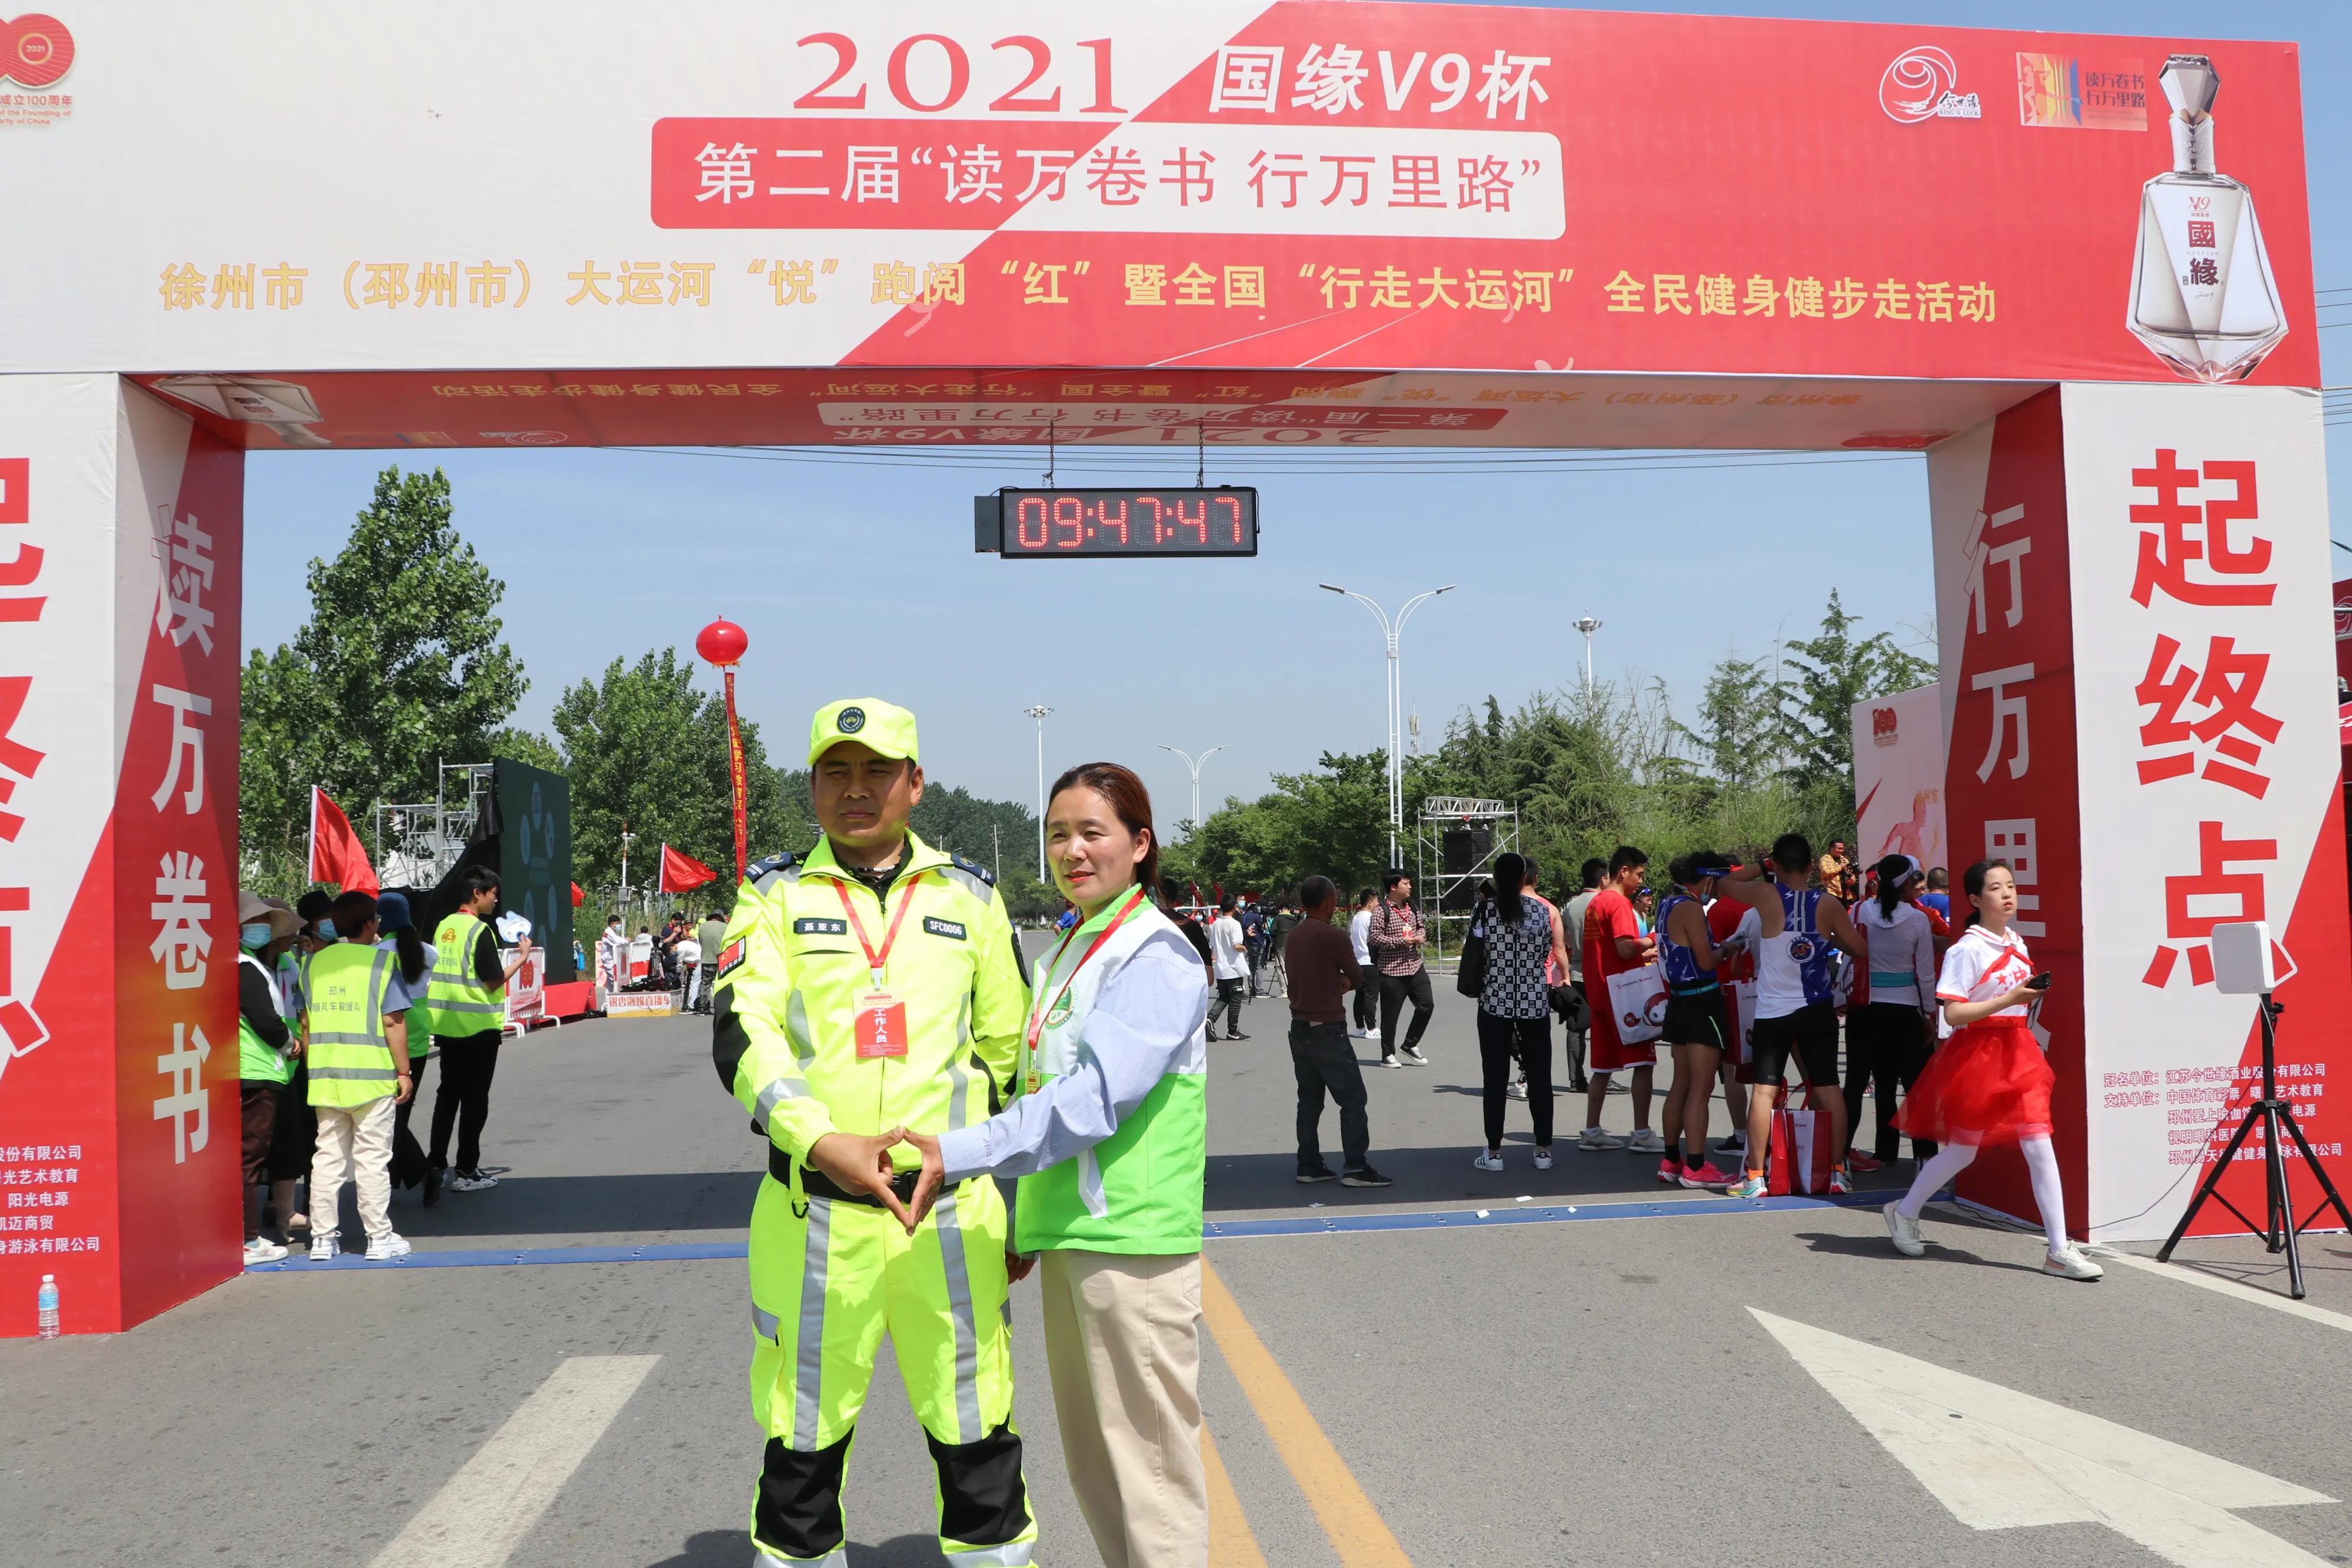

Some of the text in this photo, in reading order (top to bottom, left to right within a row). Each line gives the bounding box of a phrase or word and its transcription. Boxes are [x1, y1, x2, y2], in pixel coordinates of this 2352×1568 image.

[793, 32, 1551, 120] 2021 国缘V9杯
[2086, 71, 2145, 89] 读万卷书
[2086, 90, 2146, 108] 行万里路
[1018, 497, 1240, 547] 09:47:47
[1963, 503, 2052, 1051] 行万里
[149, 504, 214, 1165] 读万卷书
[804, 923, 841, 932] 聂亚东
[929, 920, 962, 935] SFC0006
[874, 1008, 888, 1043] 工作人员
[0, 1168, 79, 1185] 光艺术教育
[8, 1191, 69, 1208] 阳光电源
